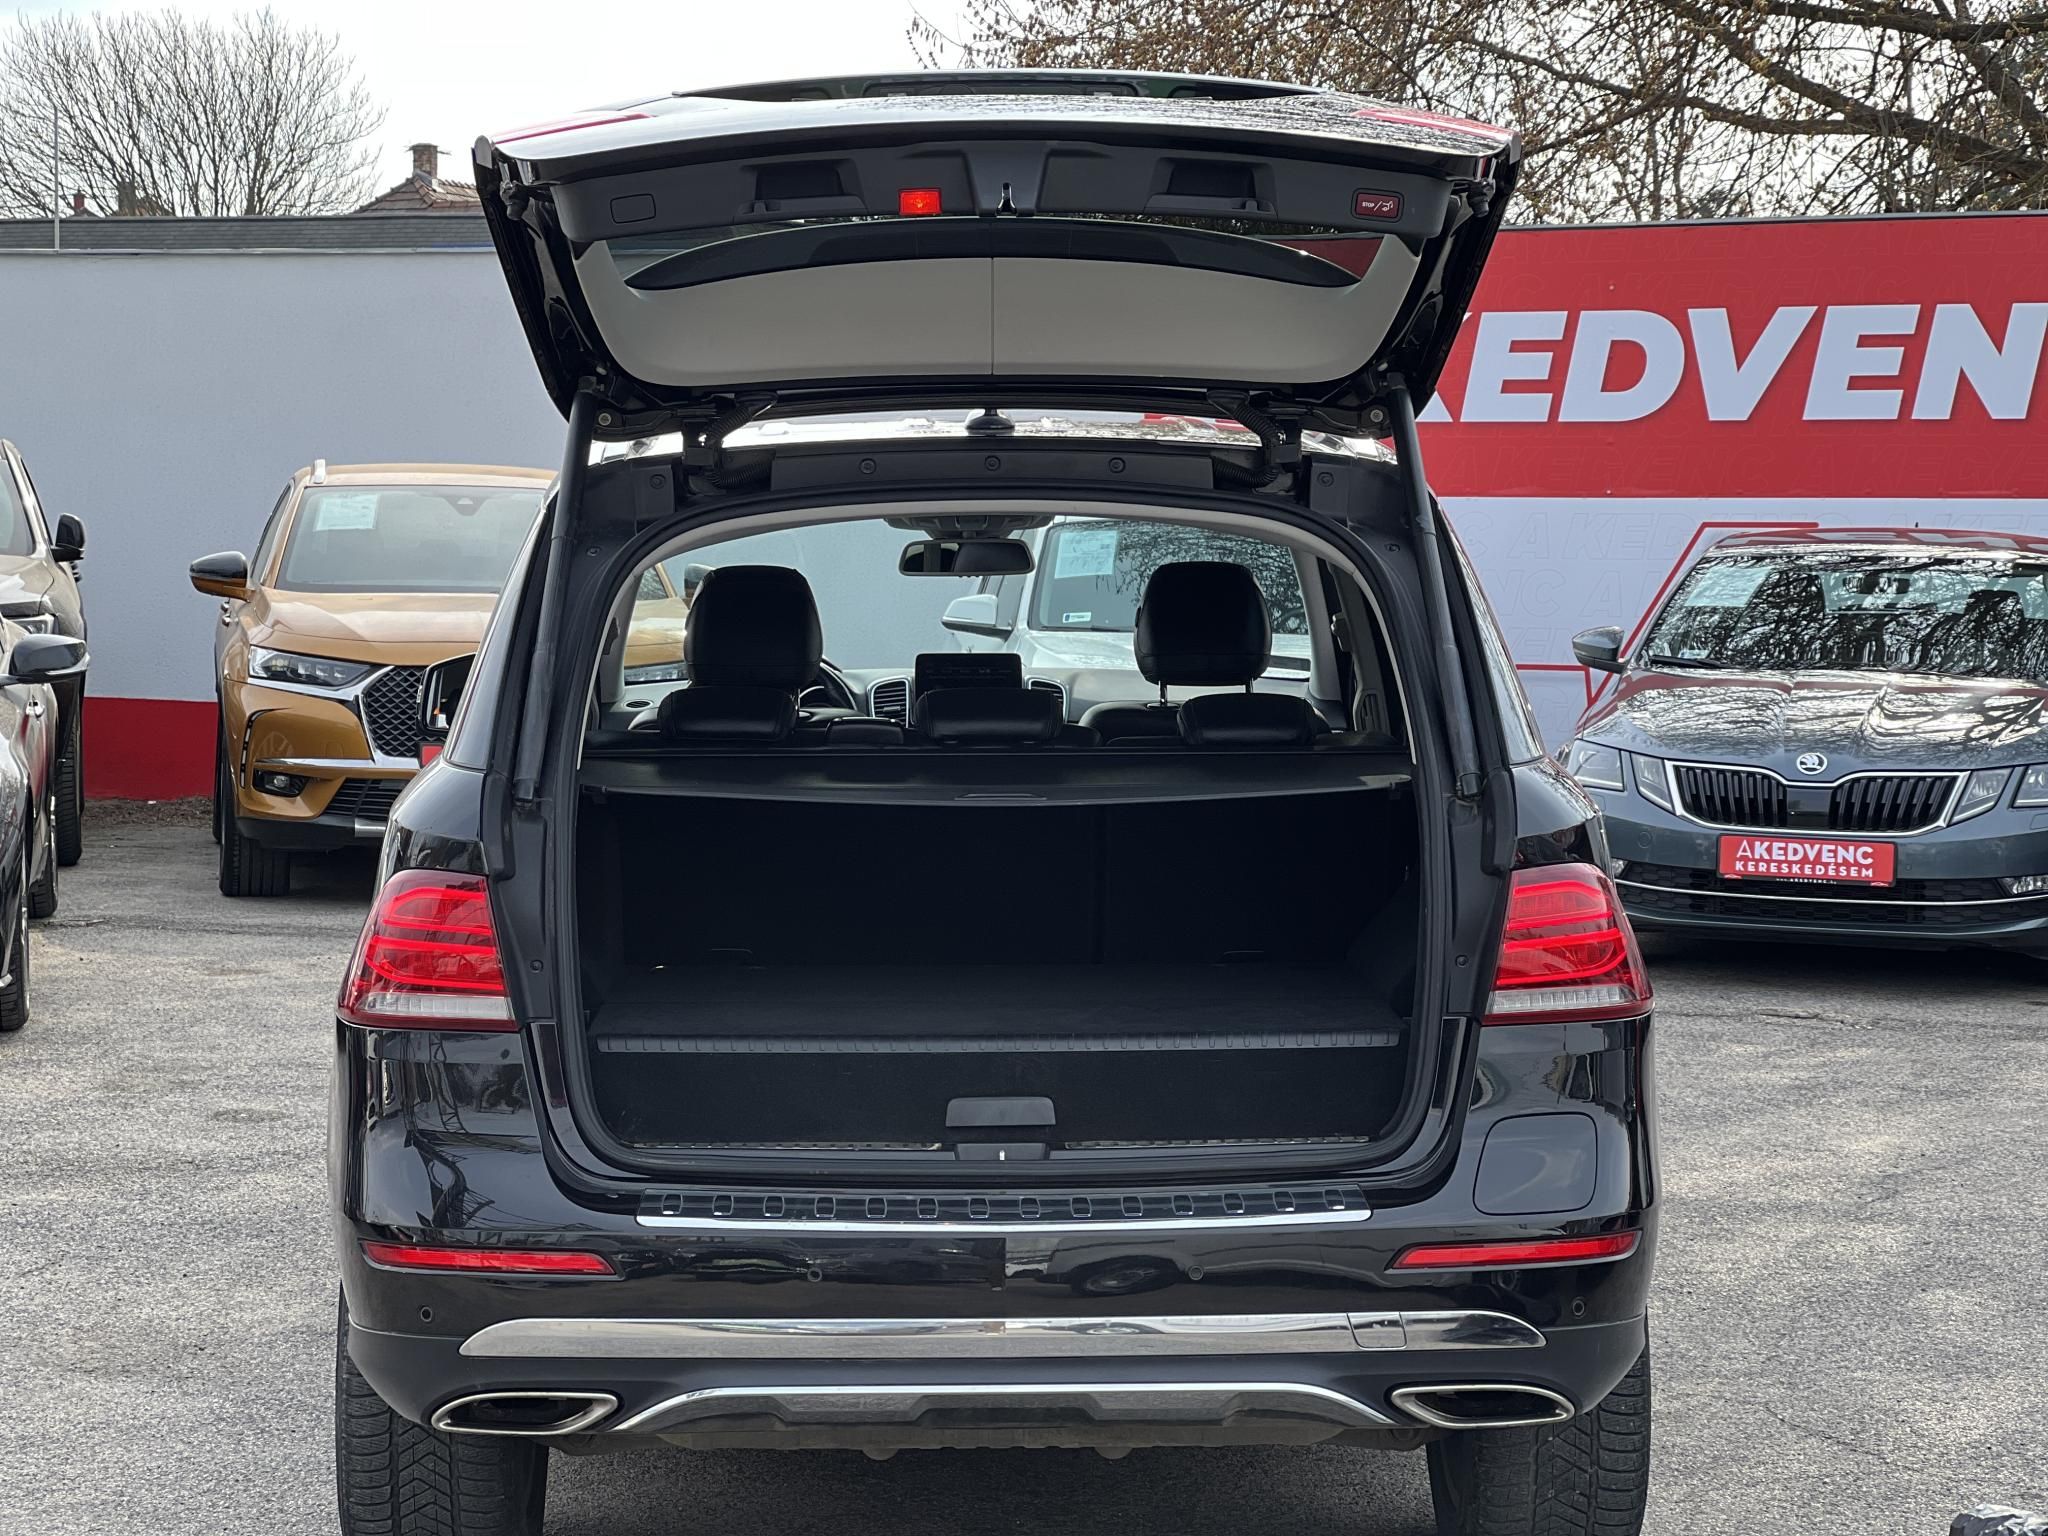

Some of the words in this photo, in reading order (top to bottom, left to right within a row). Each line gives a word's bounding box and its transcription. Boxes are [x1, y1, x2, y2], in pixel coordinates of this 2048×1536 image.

[1415, 303, 2048, 422] EDVEN
[1736, 839, 1873, 865] AKEDVENC
[1735, 860, 1873, 878] KERESKEDÉSEM
